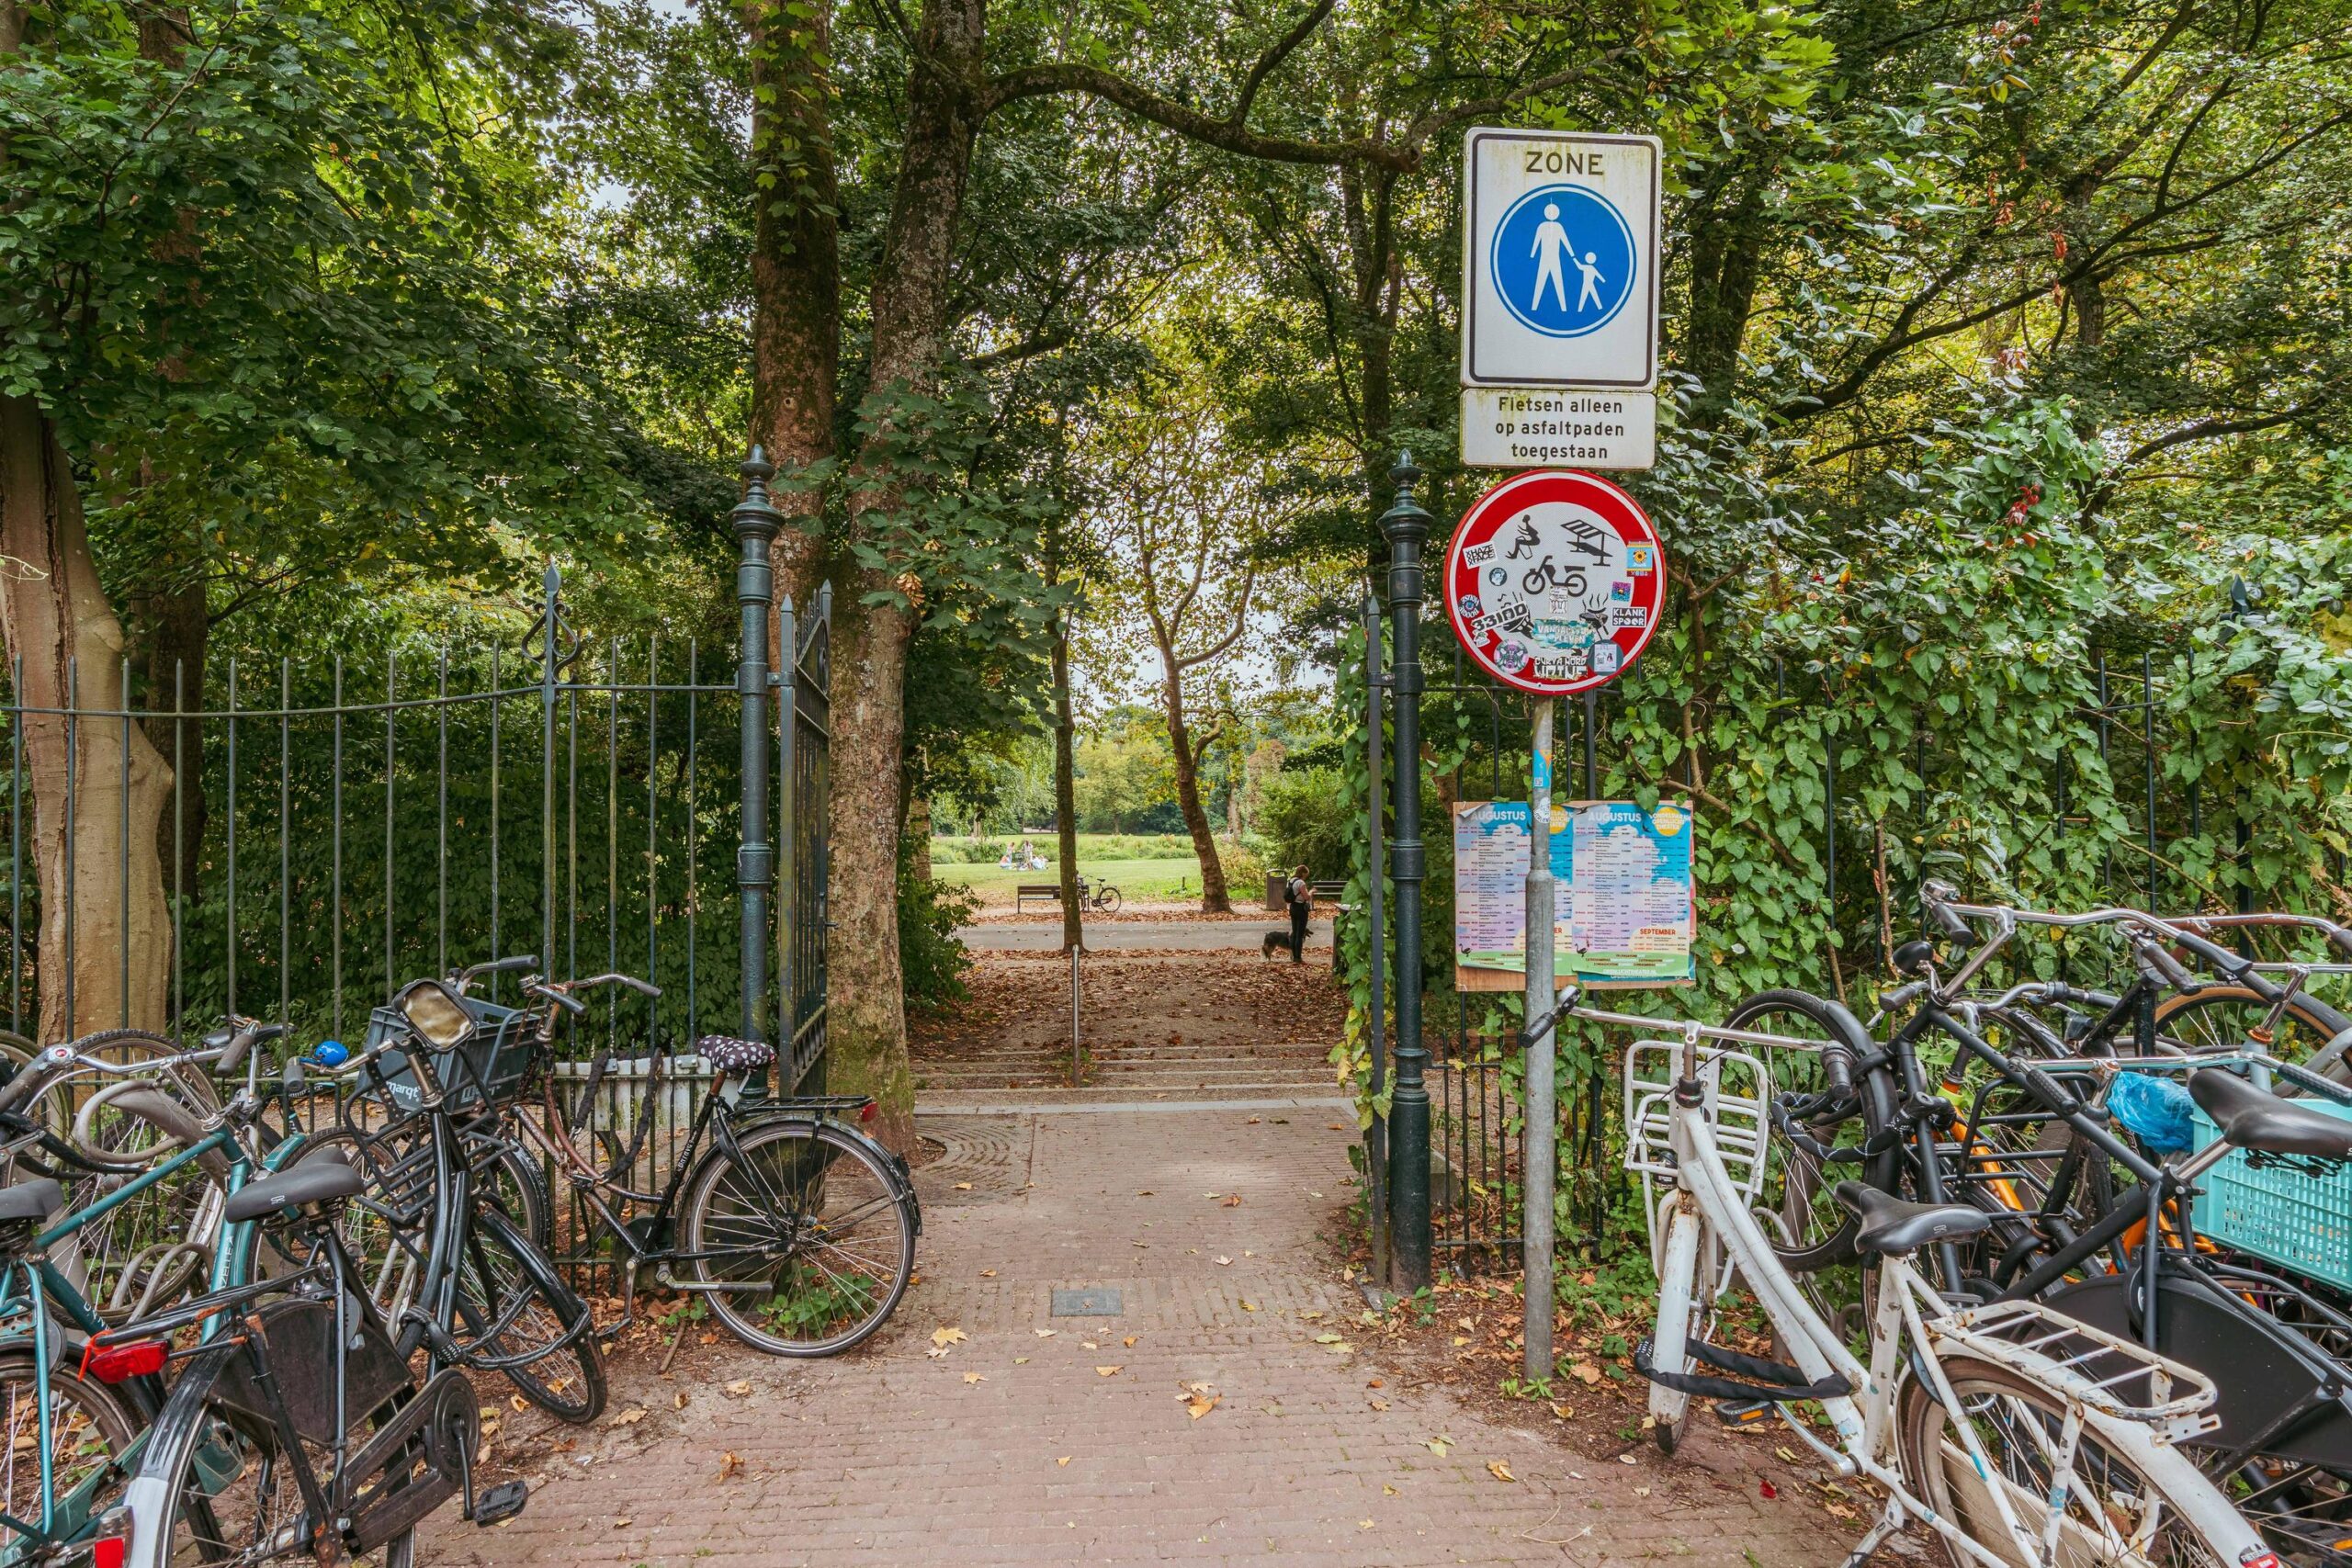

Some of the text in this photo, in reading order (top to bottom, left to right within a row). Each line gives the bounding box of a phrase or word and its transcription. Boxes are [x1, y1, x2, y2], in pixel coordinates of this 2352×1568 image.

[1525, 151, 1603, 175] ZONE
[1498, 396, 1623, 413] Fietsen alleen
[1496, 421, 1624, 438] op asfaltpaden
[1511, 443, 1608, 462] toegestaan
[1470, 544, 1493, 556] HAZE
[1612, 608, 1645, 616] KLANK
[1612, 617, 1645, 626] SPOOR
[1471, 810, 1526, 820] AUGUSTUS
[1588, 812, 1642, 822] AUGUSTUS
[1639, 928, 1677, 936] SEPTEMBER
